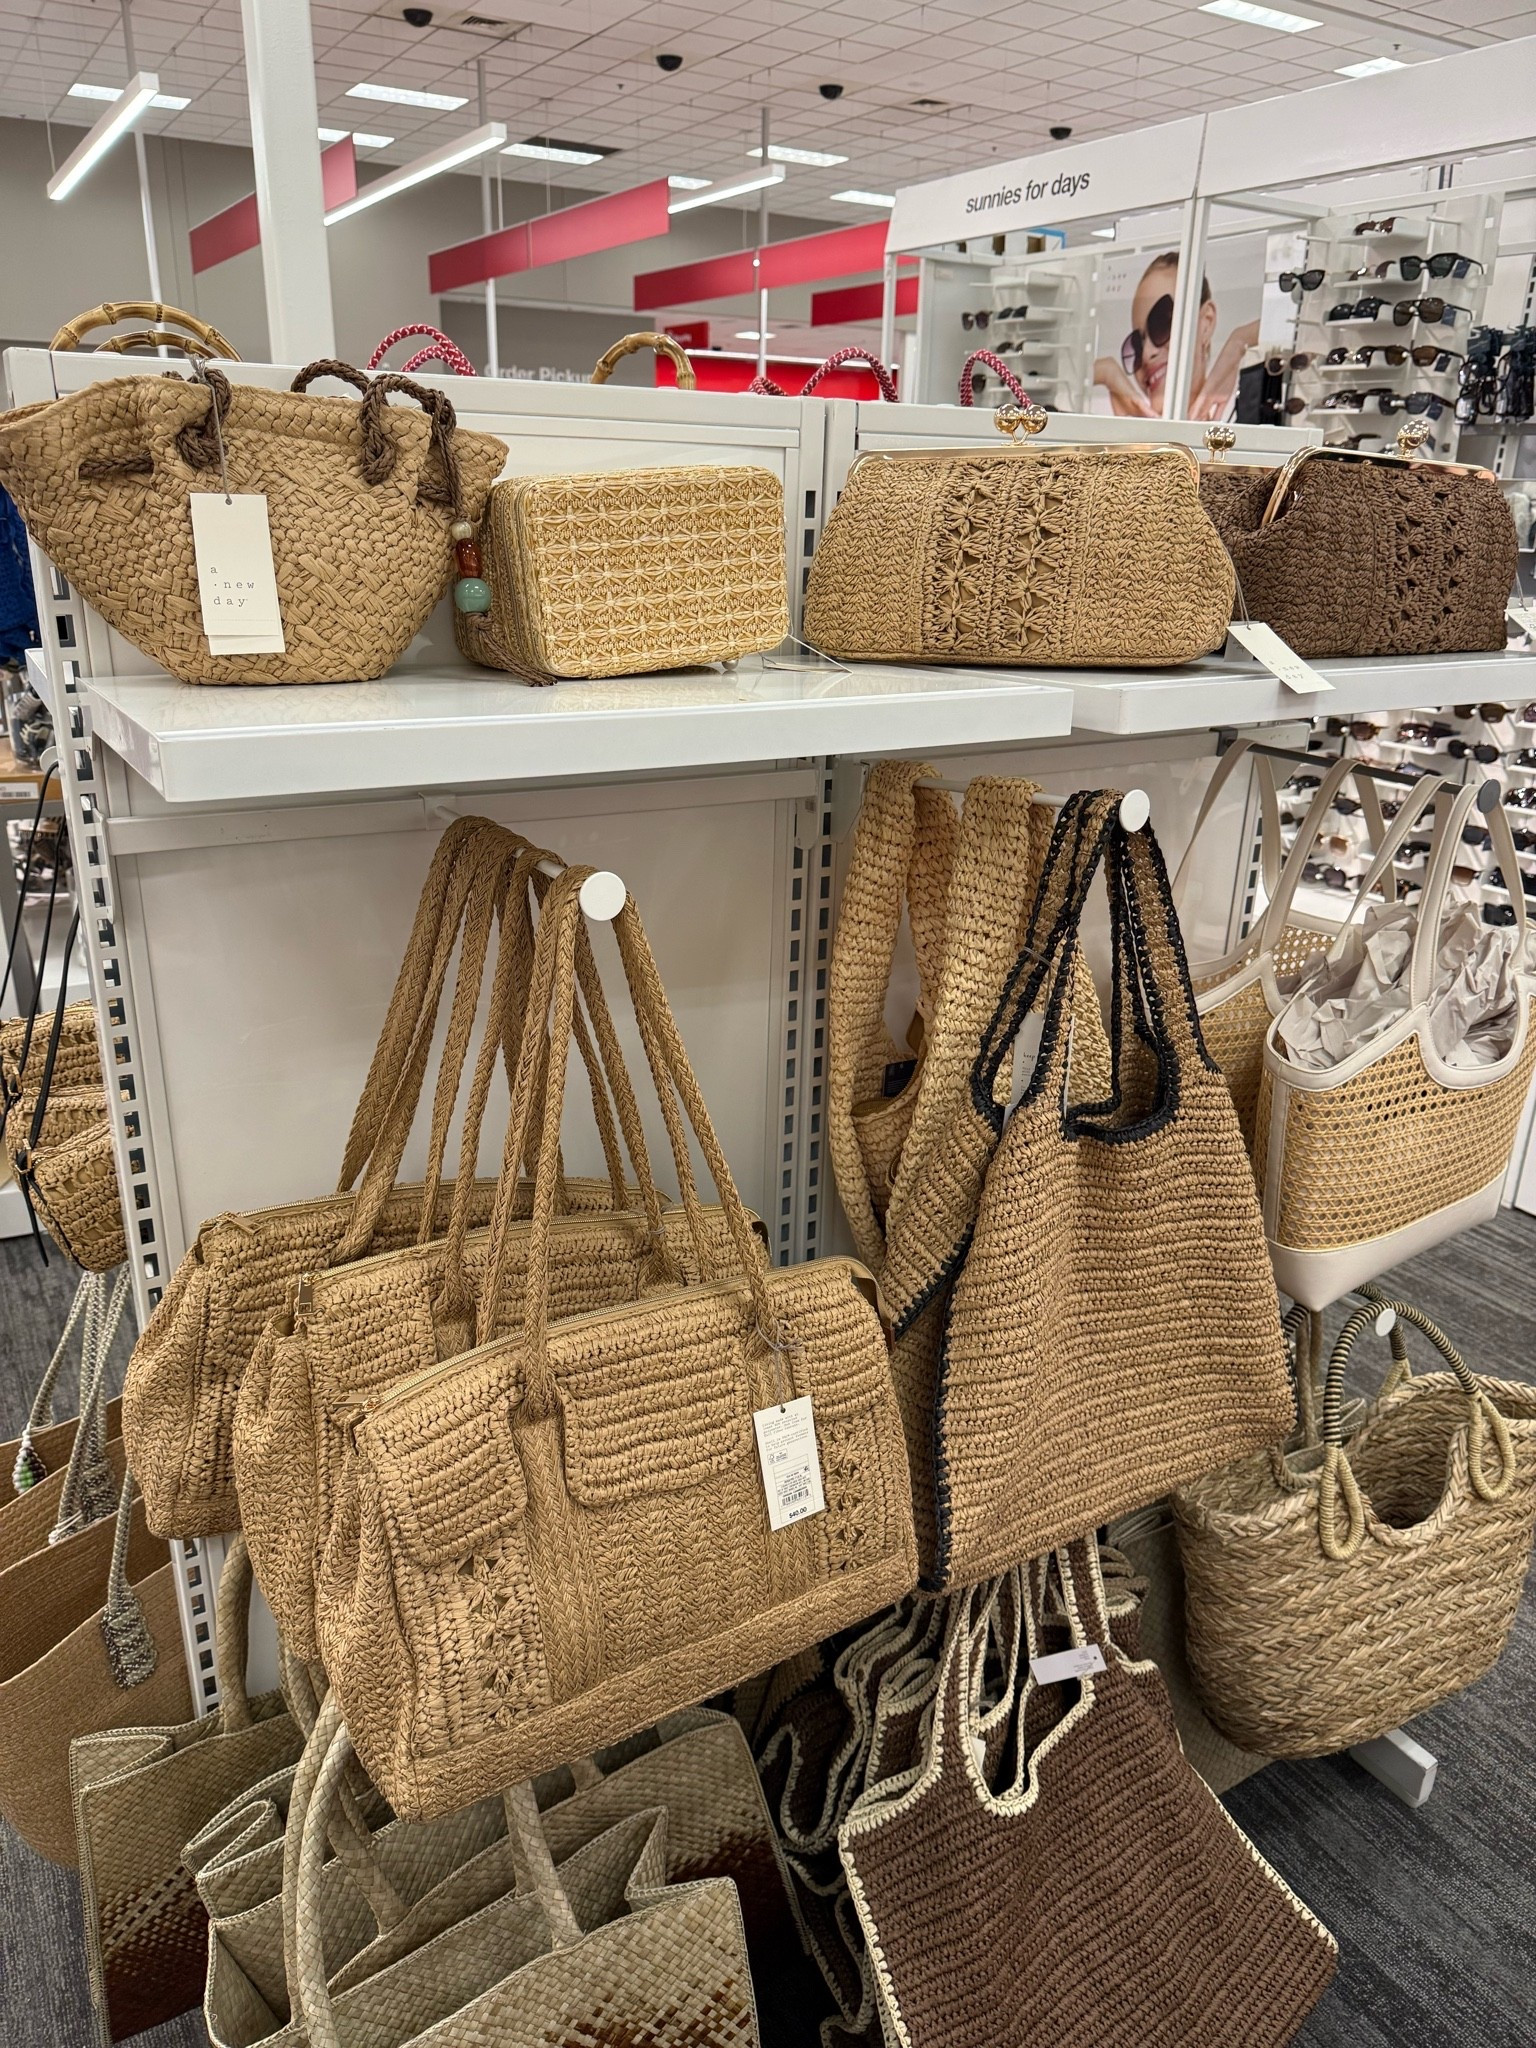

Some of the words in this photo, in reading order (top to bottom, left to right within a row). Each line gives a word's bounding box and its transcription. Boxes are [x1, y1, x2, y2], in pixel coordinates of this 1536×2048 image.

[966, 186, 1022, 214] sunnies
[1025, 180, 1048, 202] for
[1051, 172, 1090, 198] days
[210, 566, 218, 574] a
[213, 596, 246, 608] day
[789, 1506, 807, 1518] $40.00
